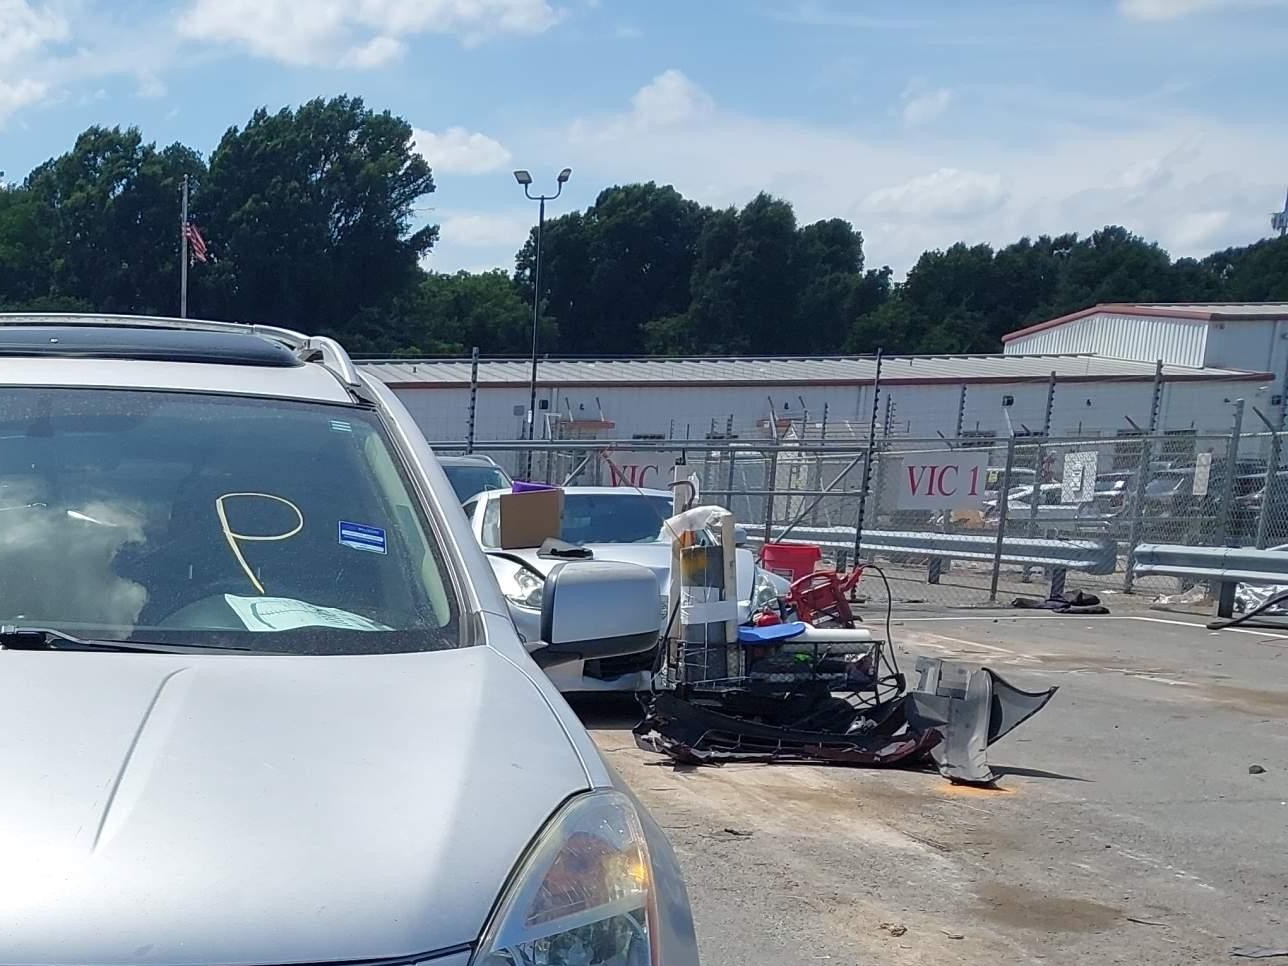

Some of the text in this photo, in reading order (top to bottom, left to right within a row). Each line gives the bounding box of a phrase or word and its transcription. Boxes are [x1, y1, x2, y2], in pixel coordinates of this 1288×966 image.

[907, 465, 979, 496] VIC 1
[215, 492, 304, 594] P
